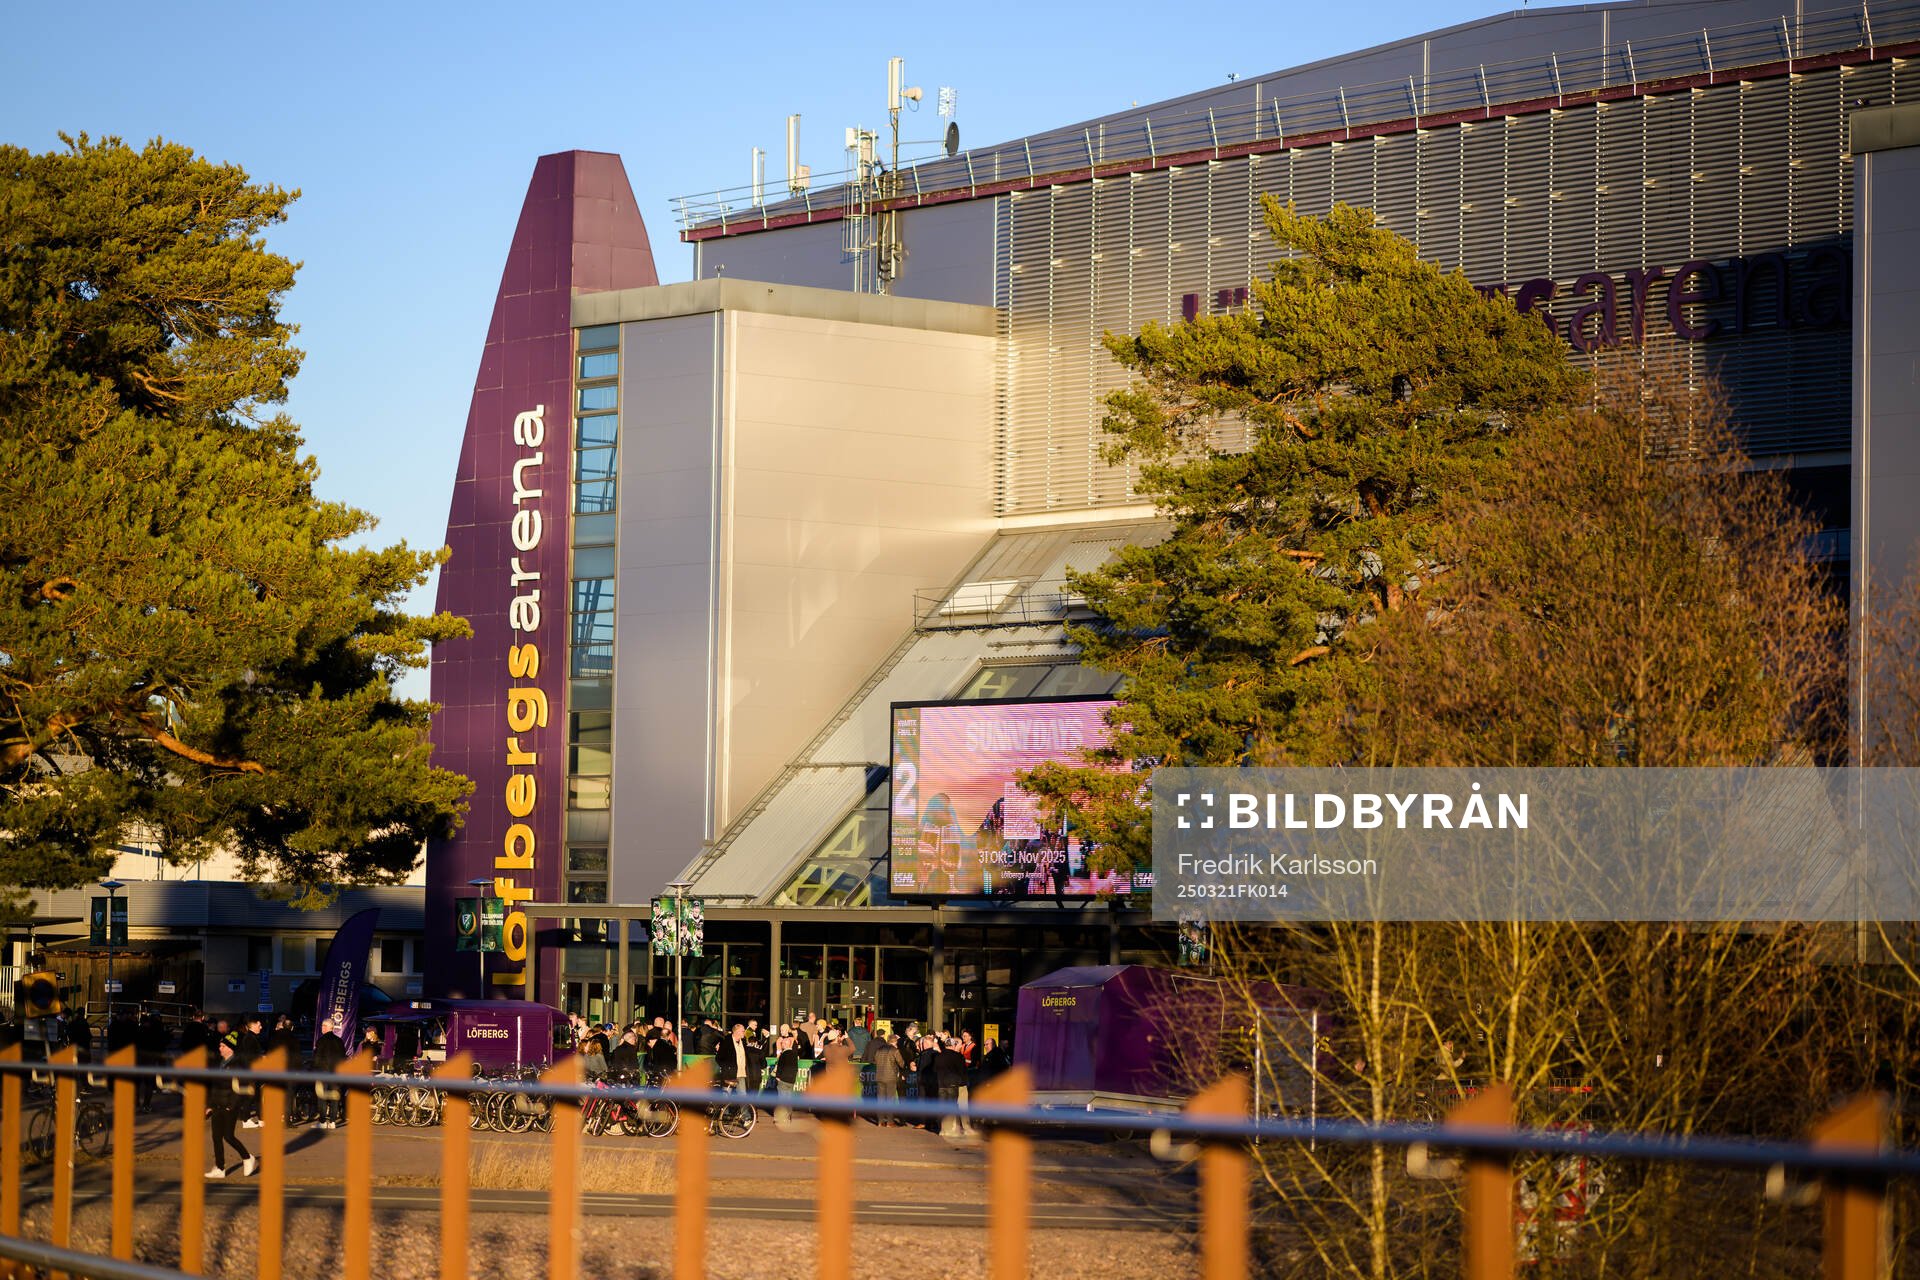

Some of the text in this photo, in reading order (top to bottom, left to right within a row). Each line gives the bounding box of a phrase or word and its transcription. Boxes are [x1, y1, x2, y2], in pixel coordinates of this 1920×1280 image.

[895, 763, 917, 816] 2
[978, 850, 988, 864] 31
[1018, 850, 1039, 864] Nov
[1041, 850, 1066, 864] 2025
[331, 961, 352, 1031] LÖFBERGS
[797, 984, 802, 996] 1
[854, 985, 860, 997] 2
[960, 989, 966, 1000] 4
[1042, 995, 1076, 1007] LÖFBERGS
[467, 1027, 509, 1039] LÖFBERGS
